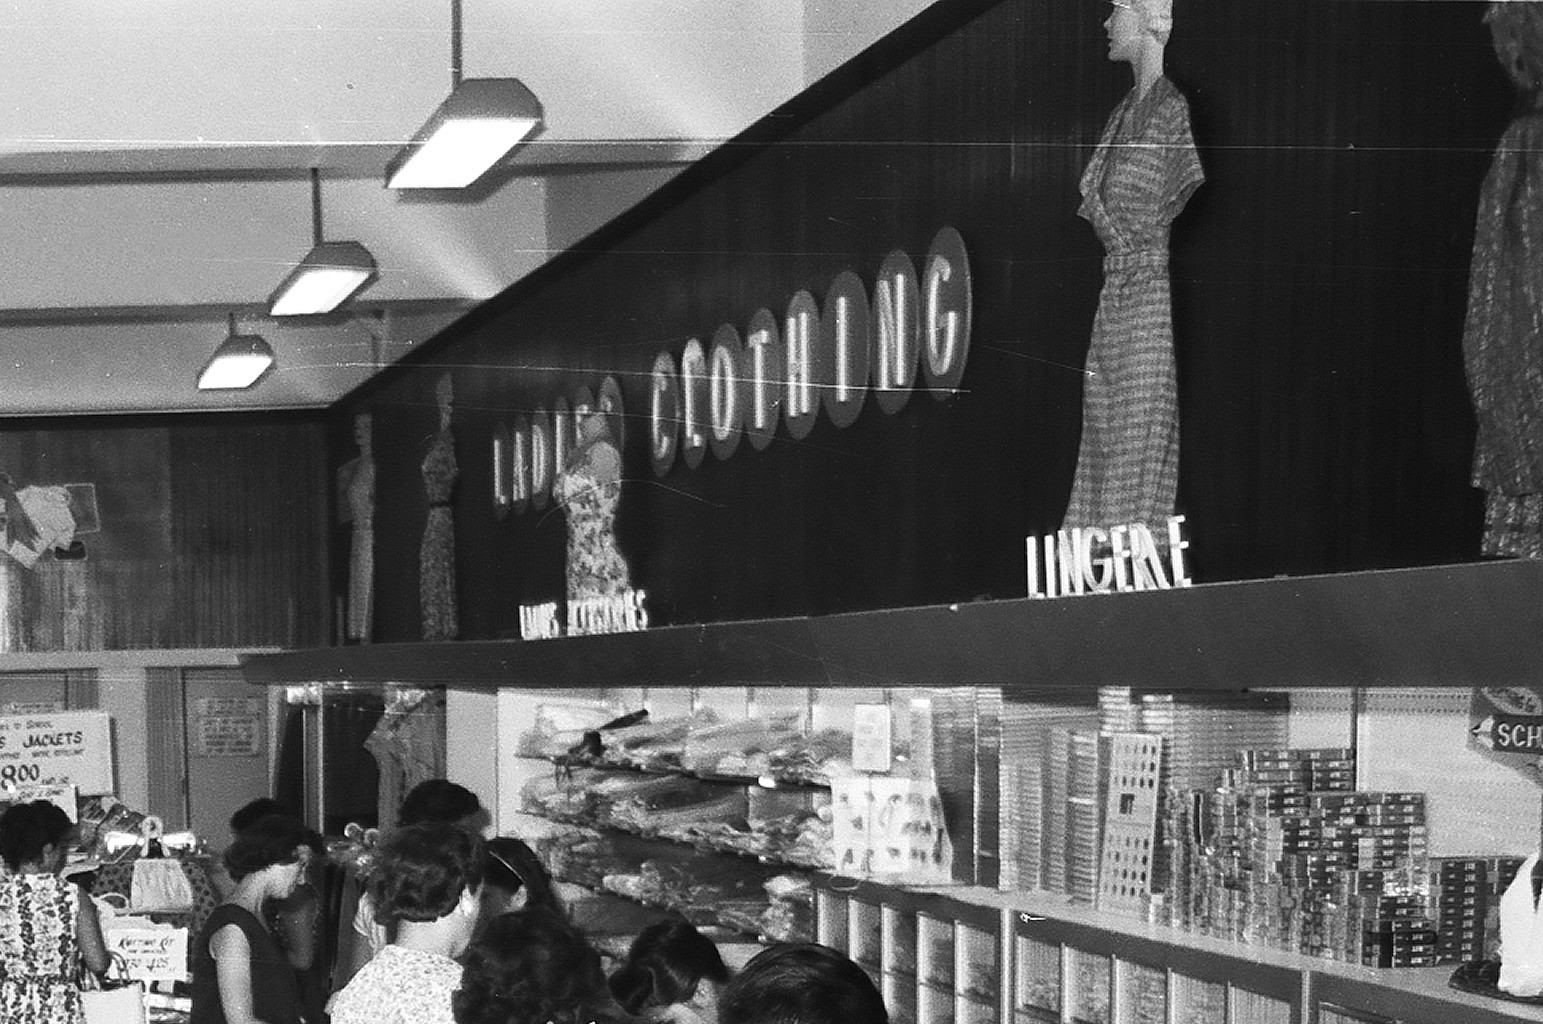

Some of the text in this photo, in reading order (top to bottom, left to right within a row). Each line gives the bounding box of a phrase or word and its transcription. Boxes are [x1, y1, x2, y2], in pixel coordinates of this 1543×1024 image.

[493, 256, 957, 504] LADIE CLOTHING
[1026, 514, 1193, 600] LINGERIE
[22, 730, 84, 748] JACKETS
